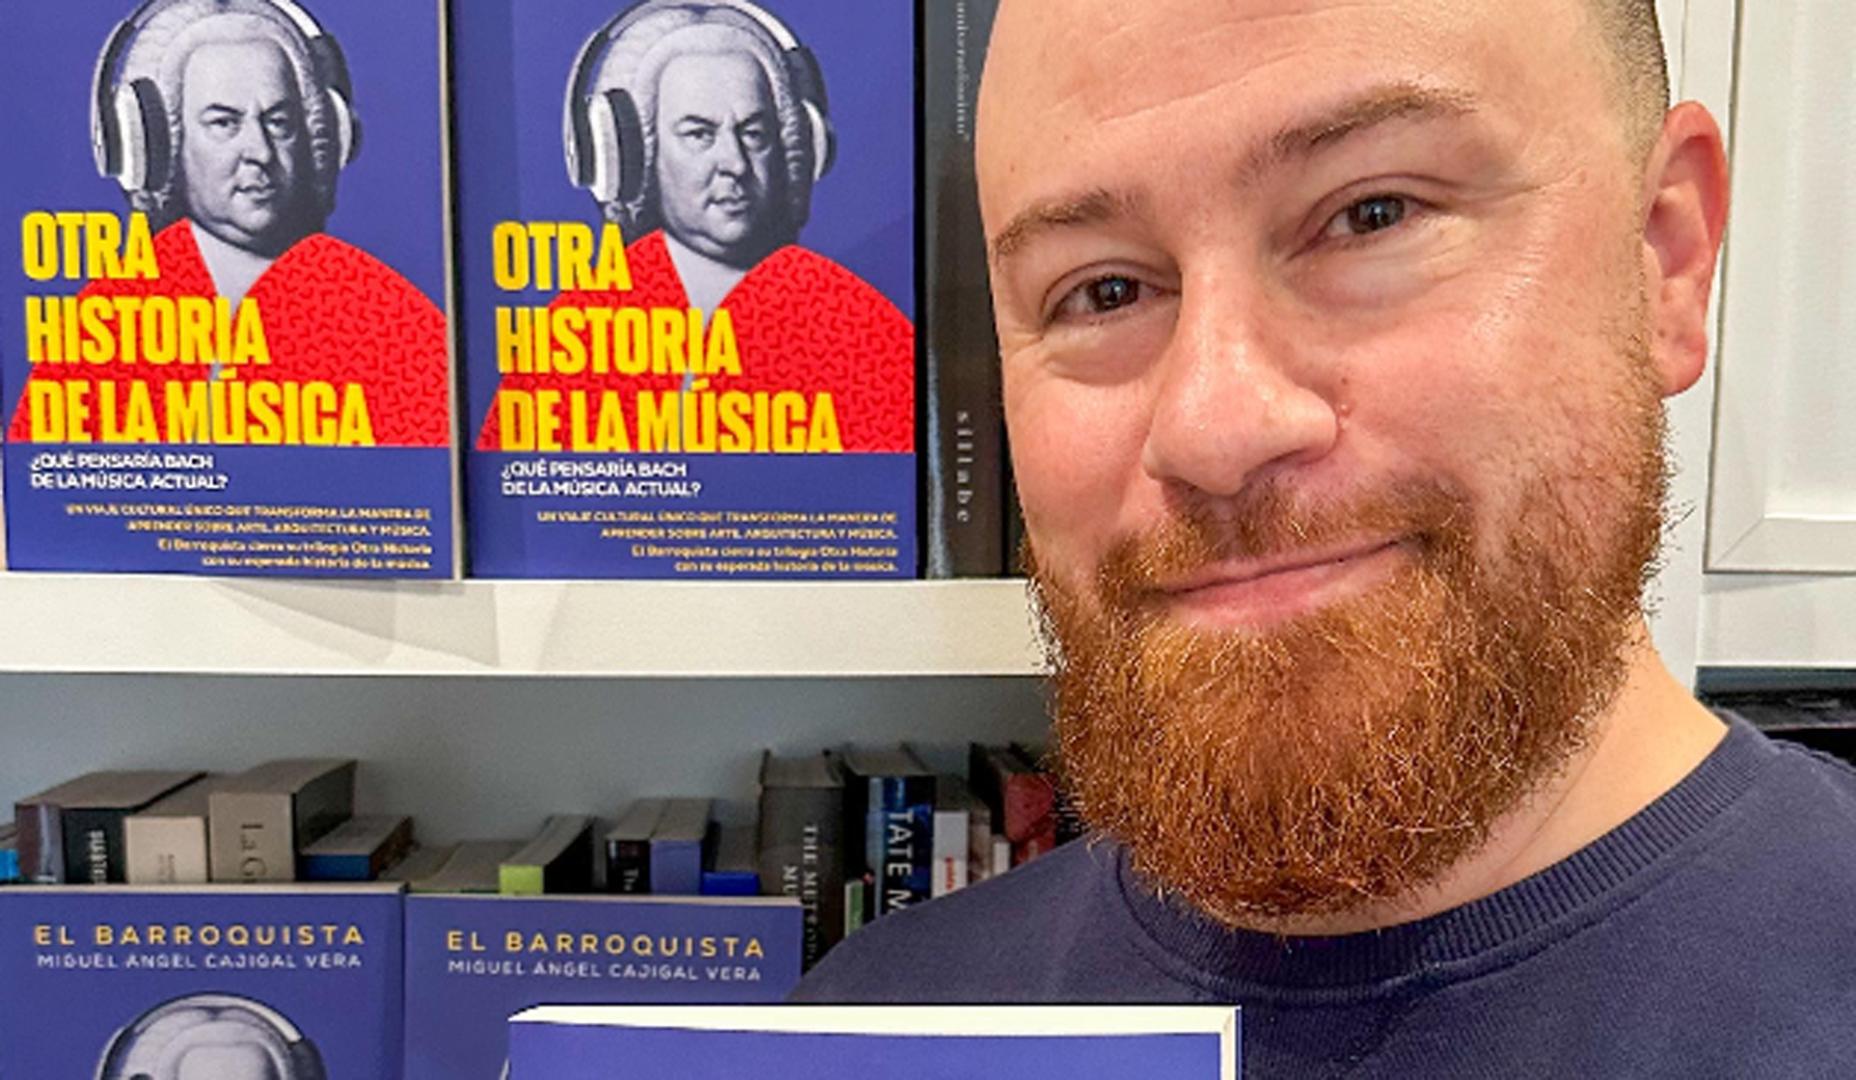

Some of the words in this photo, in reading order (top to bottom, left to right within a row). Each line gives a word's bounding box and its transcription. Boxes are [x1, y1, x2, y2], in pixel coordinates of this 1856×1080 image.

[21, 211, 160, 281] OTRA
[492, 221, 633, 292] OTRA
[25, 296, 271, 365] HISTORIA
[495, 306, 742, 375] HISTORIA
[28, 380, 93, 444] DE
[98, 381, 161, 445] LA
[165, 368, 376, 446] MÚSICA
[500, 389, 562, 452] DE
[569, 390, 630, 453] LA
[636, 378, 845, 454] MÚSICA
[31, 451, 75, 471] ¿QUÉ
[77, 450, 163, 468] PENSARÍA
[165, 454, 214, 469] BACH
[31, 473, 54, 488] DE
[56, 473, 80, 489] LA
[82, 471, 148, 489] MÚSICA
[150, 474, 229, 490] ACTUAL?
[501, 457, 547, 480] ¿QUÉ
[551, 458, 636, 477] PENSARÍA
[638, 462, 687, 478] BACH
[956, 411, 973, 522] sillabe
[502, 482, 527, 496] DE
[528, 482, 552, 496] LA
[553, 479, 620, 496] MÚSICA
[624, 481, 702, 497] ACTUAL?
[886, 808, 914, 877] TATE
[34, 925, 75, 945] EL
[95, 925, 364, 946] BARROQUISTA
[447, 931, 486, 951] EL
[505, 931, 764, 959] BARROQUISTA
[37, 953, 118, 968] MIGUEL
[204, 952, 297, 969] CAJIGAL
[304, 952, 362, 969] VERA
[448, 960, 526, 975] MIGUEL
[608, 962, 699, 980] CAJIGAL
[706, 965, 761, 981] VERA
